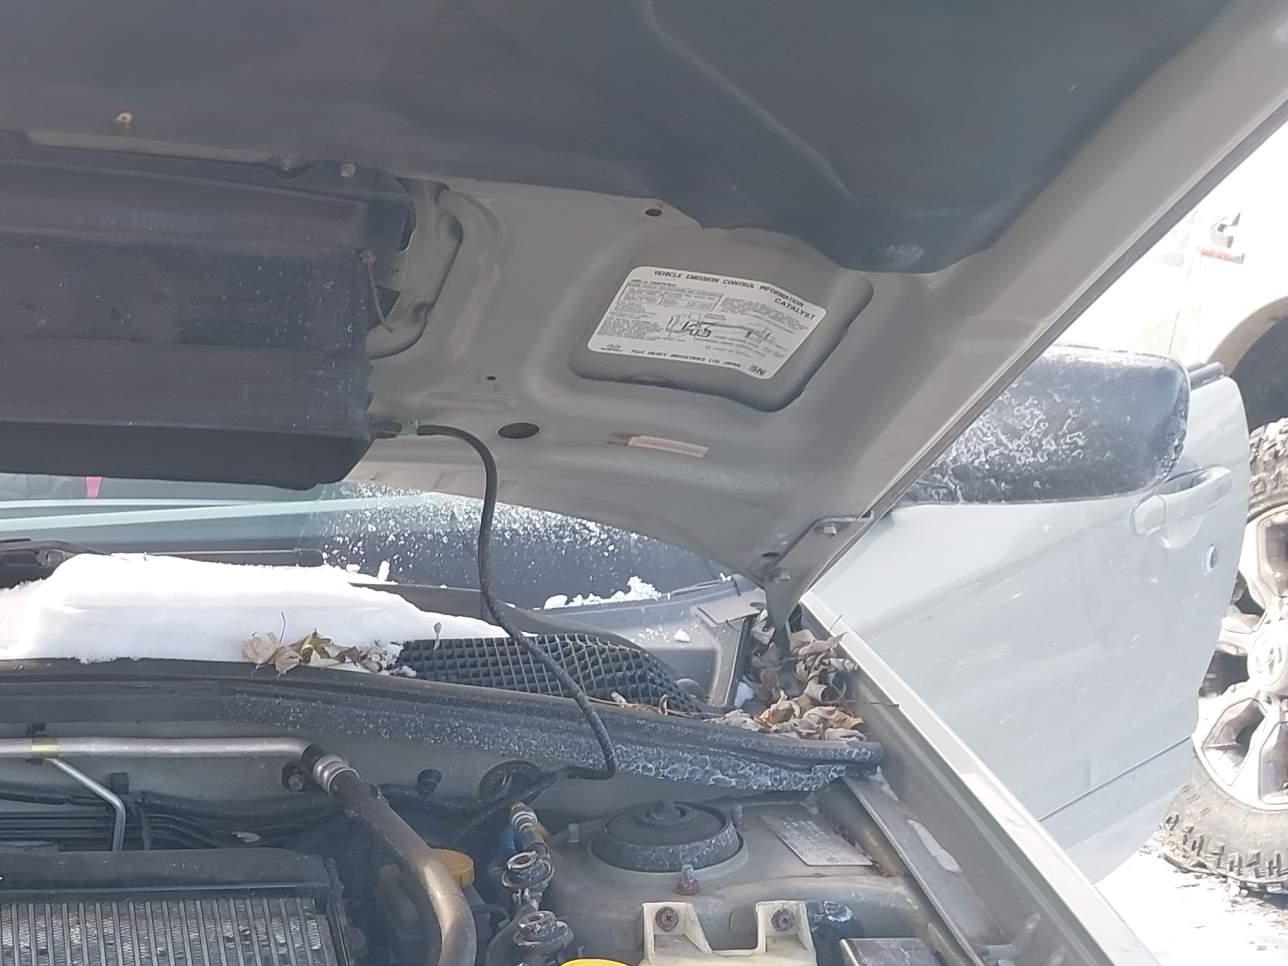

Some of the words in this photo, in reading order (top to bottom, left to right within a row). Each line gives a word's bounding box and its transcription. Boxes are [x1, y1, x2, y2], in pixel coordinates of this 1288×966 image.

[723, 279, 755, 289] CONTROL
[759, 285, 806, 307] INFORMATION
[774, 298, 816, 320] CATALYST
